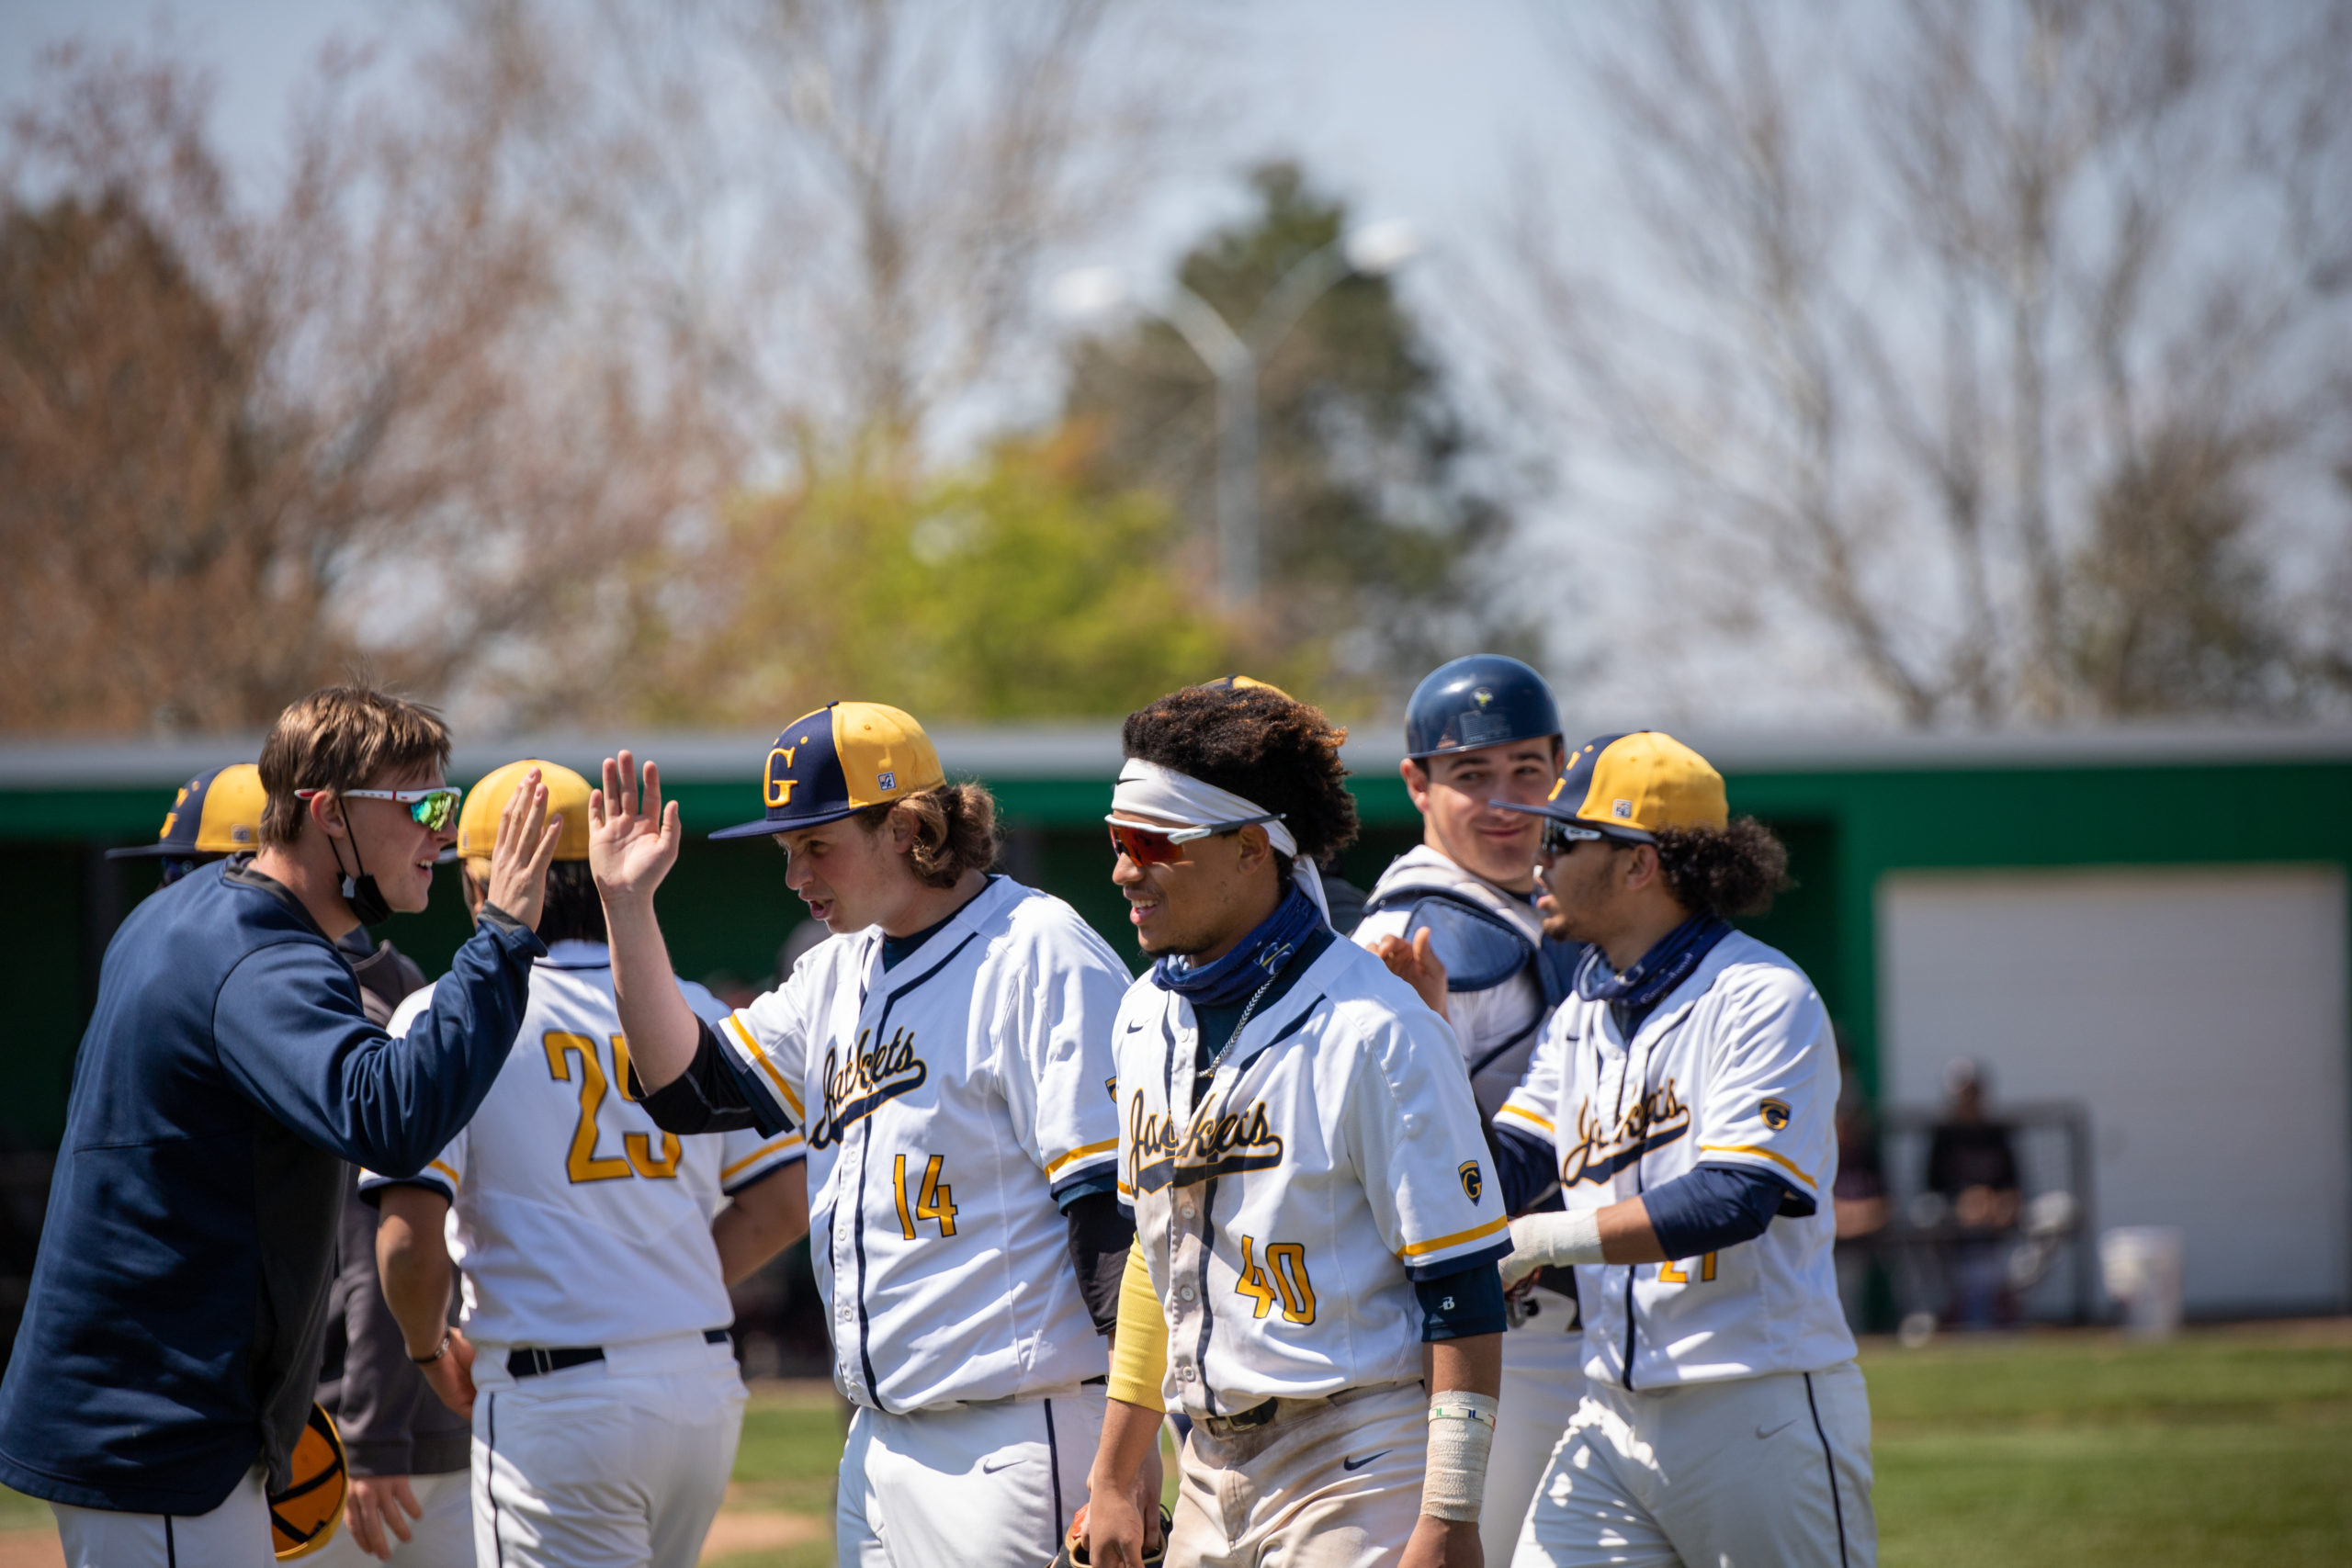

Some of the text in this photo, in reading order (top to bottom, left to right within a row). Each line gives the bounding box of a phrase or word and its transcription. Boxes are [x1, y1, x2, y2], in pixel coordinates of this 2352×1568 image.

[763, 746, 798, 808] G
[808, 1025, 927, 1151] Jackets
[1561, 1077, 1690, 1189] Jakets
[892, 1154, 958, 1241] 14
[1234, 1234, 1317, 1326] 40
